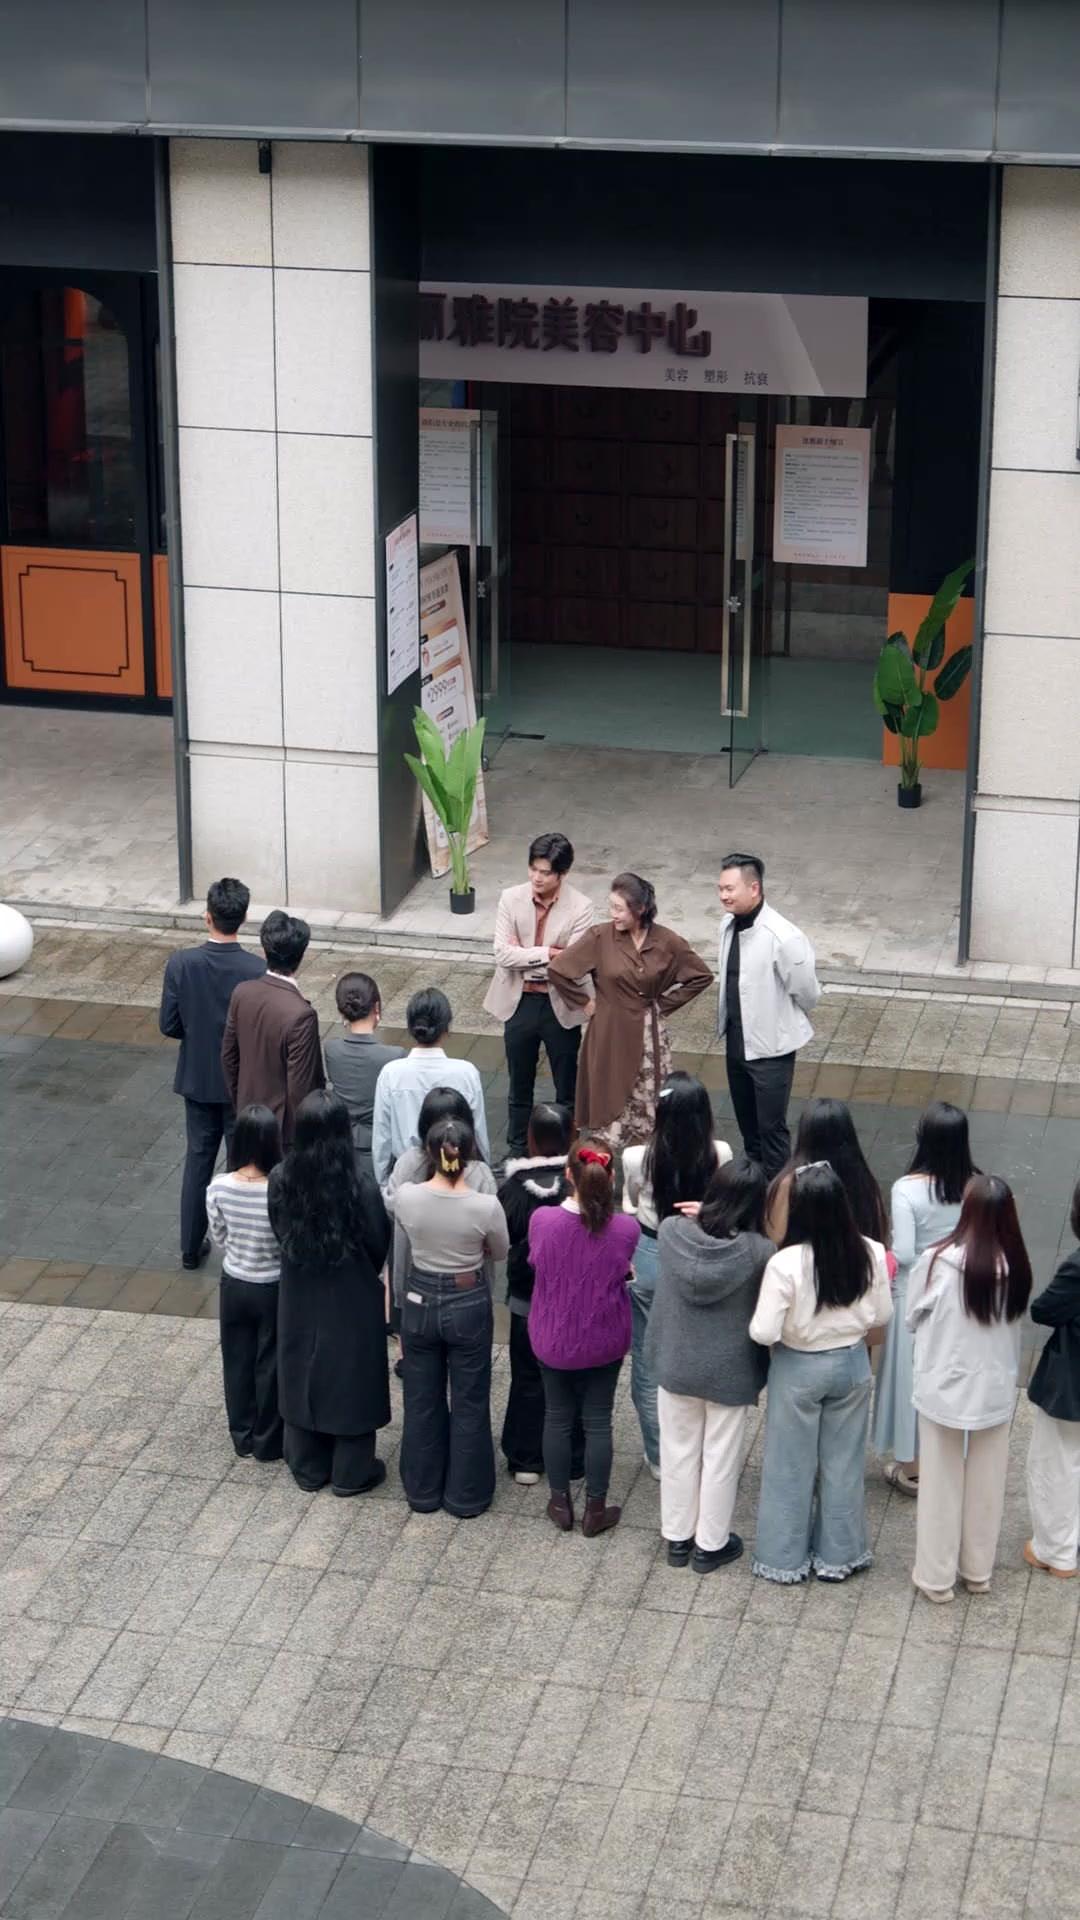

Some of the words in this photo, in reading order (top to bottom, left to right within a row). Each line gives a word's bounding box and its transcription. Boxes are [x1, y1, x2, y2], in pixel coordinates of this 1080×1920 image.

[664, 368, 688, 383] 美容
[703, 369, 728, 384] 塑形
[744, 370, 769, 386] 抗衰
